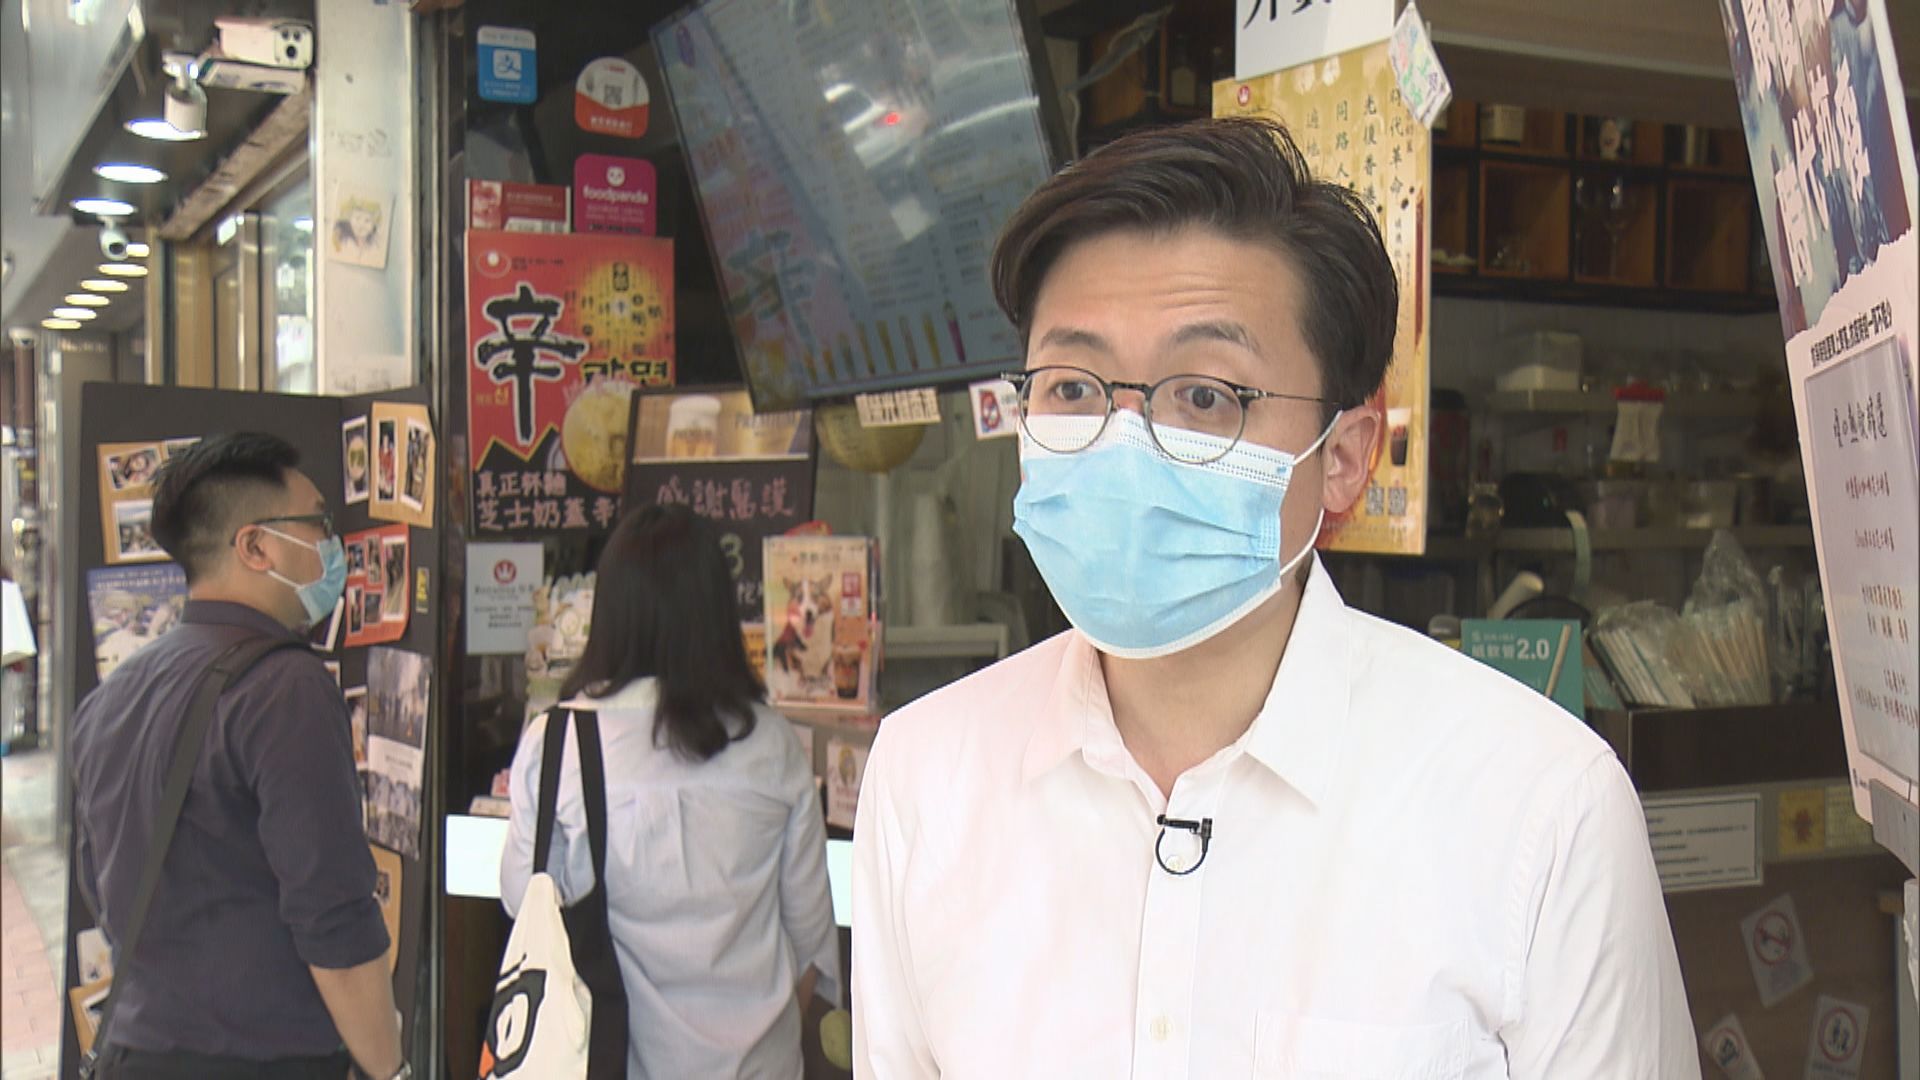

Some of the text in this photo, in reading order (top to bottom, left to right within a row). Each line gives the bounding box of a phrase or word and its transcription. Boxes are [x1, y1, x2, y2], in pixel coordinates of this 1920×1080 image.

[582, 185, 649, 204] foodpanda
[1364, 94, 1377, 206] 光復香港
[477, 283, 588, 445] 辛
